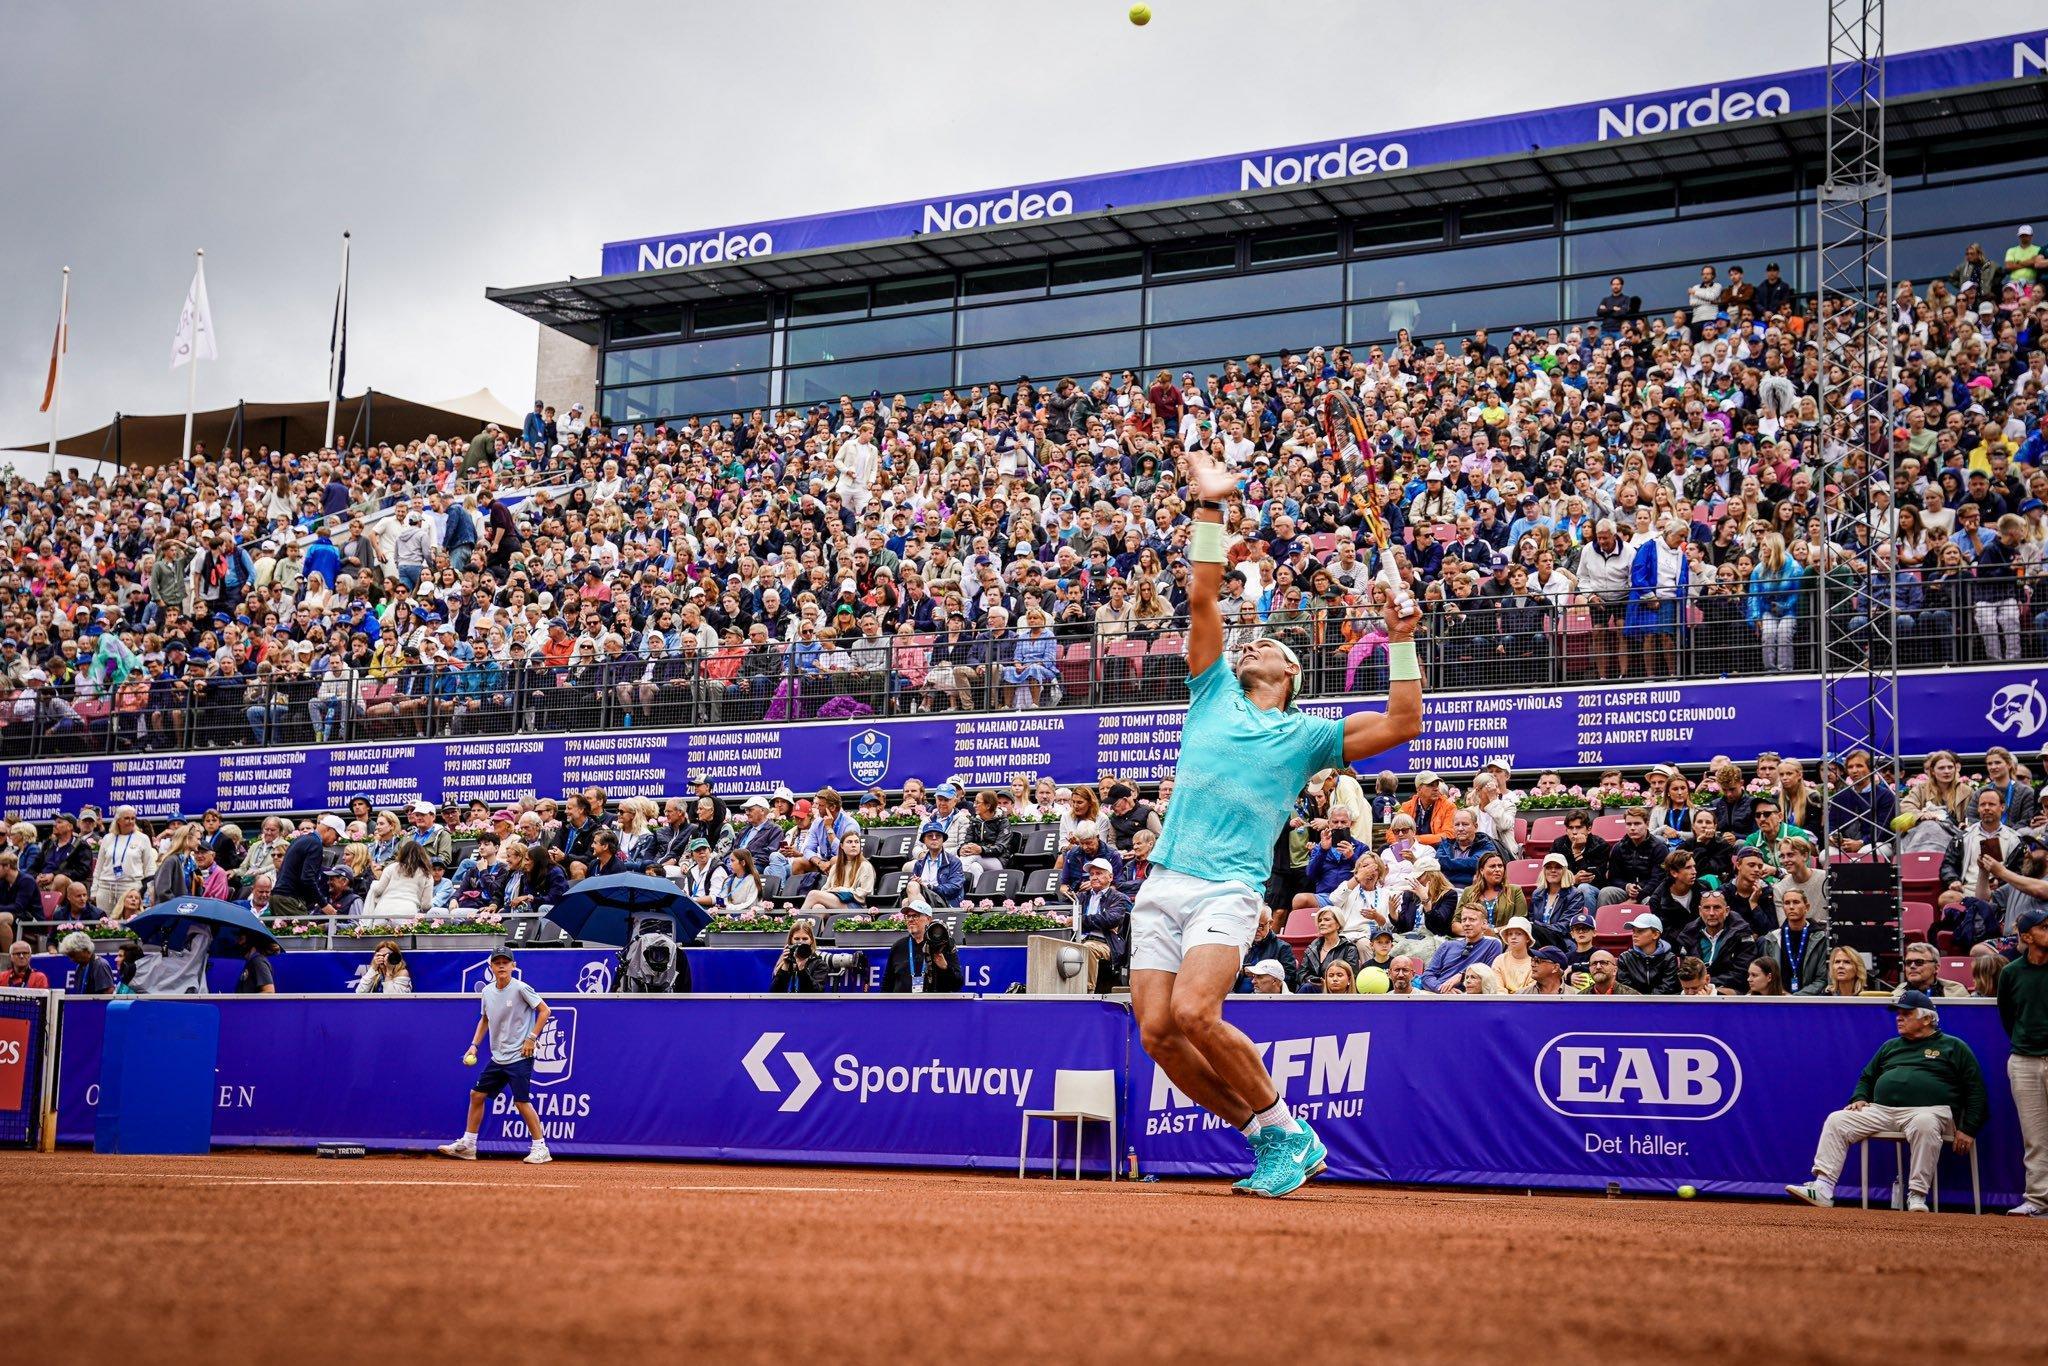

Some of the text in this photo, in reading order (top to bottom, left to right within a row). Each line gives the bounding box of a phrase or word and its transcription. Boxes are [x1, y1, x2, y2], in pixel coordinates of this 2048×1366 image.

[1598, 85, 1791, 141] Nordea
[1240, 141, 1409, 191] Nordea
[923, 189, 1074, 234] Nordea
[638, 231, 773, 272] Nordea
[1434, 700, 1474, 714] ALBERT
[1476, 696, 1562, 712] RAMOS-VIÑOLAS
[1578, 690, 1680, 707] 2021 CASPER RUUD
[1098, 713, 1187, 728] 2008 TOMMY ROBRE
[1578, 706, 1736, 726] 2022 FRANCISCO CERUNDOLO
[956, 718, 1064, 734] 2004 MARIANO ZABALETA
[1434, 719, 1464, 732] DAVID
[1468, 718, 1508, 731] FERRER
[688, 732, 780, 746] 2000 MAGNUS NORMAN
[1098, 730, 1181, 745] 2009 ROBIN SÖDER
[1578, 728, 1694, 744] 2023 ANDREY RUBLEV
[445, 742, 544, 756] 1992 MAGNUS GUSTAFSSON
[564, 736, 668, 751] 1996 MAGNUS GUSTAFSSON
[954, 736, 1040, 751] 2005 RAFAEL NADAL
[1408, 736, 1509, 752] 2018 FABIO FOGNINI
[220, 751, 306, 767] 1984 HENRIK SUNDSTRÖM
[330, 746, 415, 762] 1988 MARCELO FILIPPINI
[564, 753, 651, 766] 1997 MAGNUS NORMAN
[688, 748, 782, 762] 2001 ANDREA GAUDENZI
[954, 753, 1050, 768] 2006 TOMMY ROBREDO
[1098, 750, 1118, 762] 2010
[1120, 747, 1160, 762] NICOLÁS
[1578, 751, 1602, 764] 2024
[112, 761, 127, 772] 1980
[128, 758, 154, 772] BALÁZS
[329, 762, 390, 776] 1989 PAOLO CANÉ
[444, 758, 512, 772] 1993 HORST SKOFF
[853, 760, 884, 770] NORDEA
[1408, 758, 1432, 770] 2019
[1434, 755, 1478, 769] NICOLAS
[8, 763, 89, 777] 1976 ANTONIO ZUGARELLI
[218, 768, 292, 782] 1985 MATS WILANDER
[562, 768, 666, 782] 1998 MAGNUS GUSTAFSSON
[707, 766, 738, 778] CARLOS
[1120, 767, 1149, 778] ROBIN
[7, 778, 94, 791] 1977 CORRADO BARAZZUTTI
[111, 774, 186, 787] 1981 THIERRY TULASNE
[328, 778, 418, 792] 1990 RICHARD FROMBERG
[443, 773, 532, 786] 1994 BERND KARBACHER
[976, 772, 1002, 784] DAVID
[110, 788, 181, 801] 1982 MATS WILANDER
[217, 782, 290, 797] 1986 EMILIO SÁNCHEZ
[638, 782, 664, 796] MARÍN
[710, 782, 743, 794] ARIANO
[6, 793, 62, 805] 1978 BJÖRN BORG
[327, 796, 342, 807] 1991
[460, 790, 500, 802] FERNANDO
[216, 796, 293, 812] 1987 JOAKIM NYSTRÖM
[832, 1054, 1033, 1107] Sportway
[1557, 1047, 1722, 1105] EAB
[1146, 1113, 1198, 1135] BÄST
[1328, 1099, 1363, 1119] NU!
[502, 1120, 575, 1139] KOMUN
[1585, 1133, 1689, 1156] Det håller.
